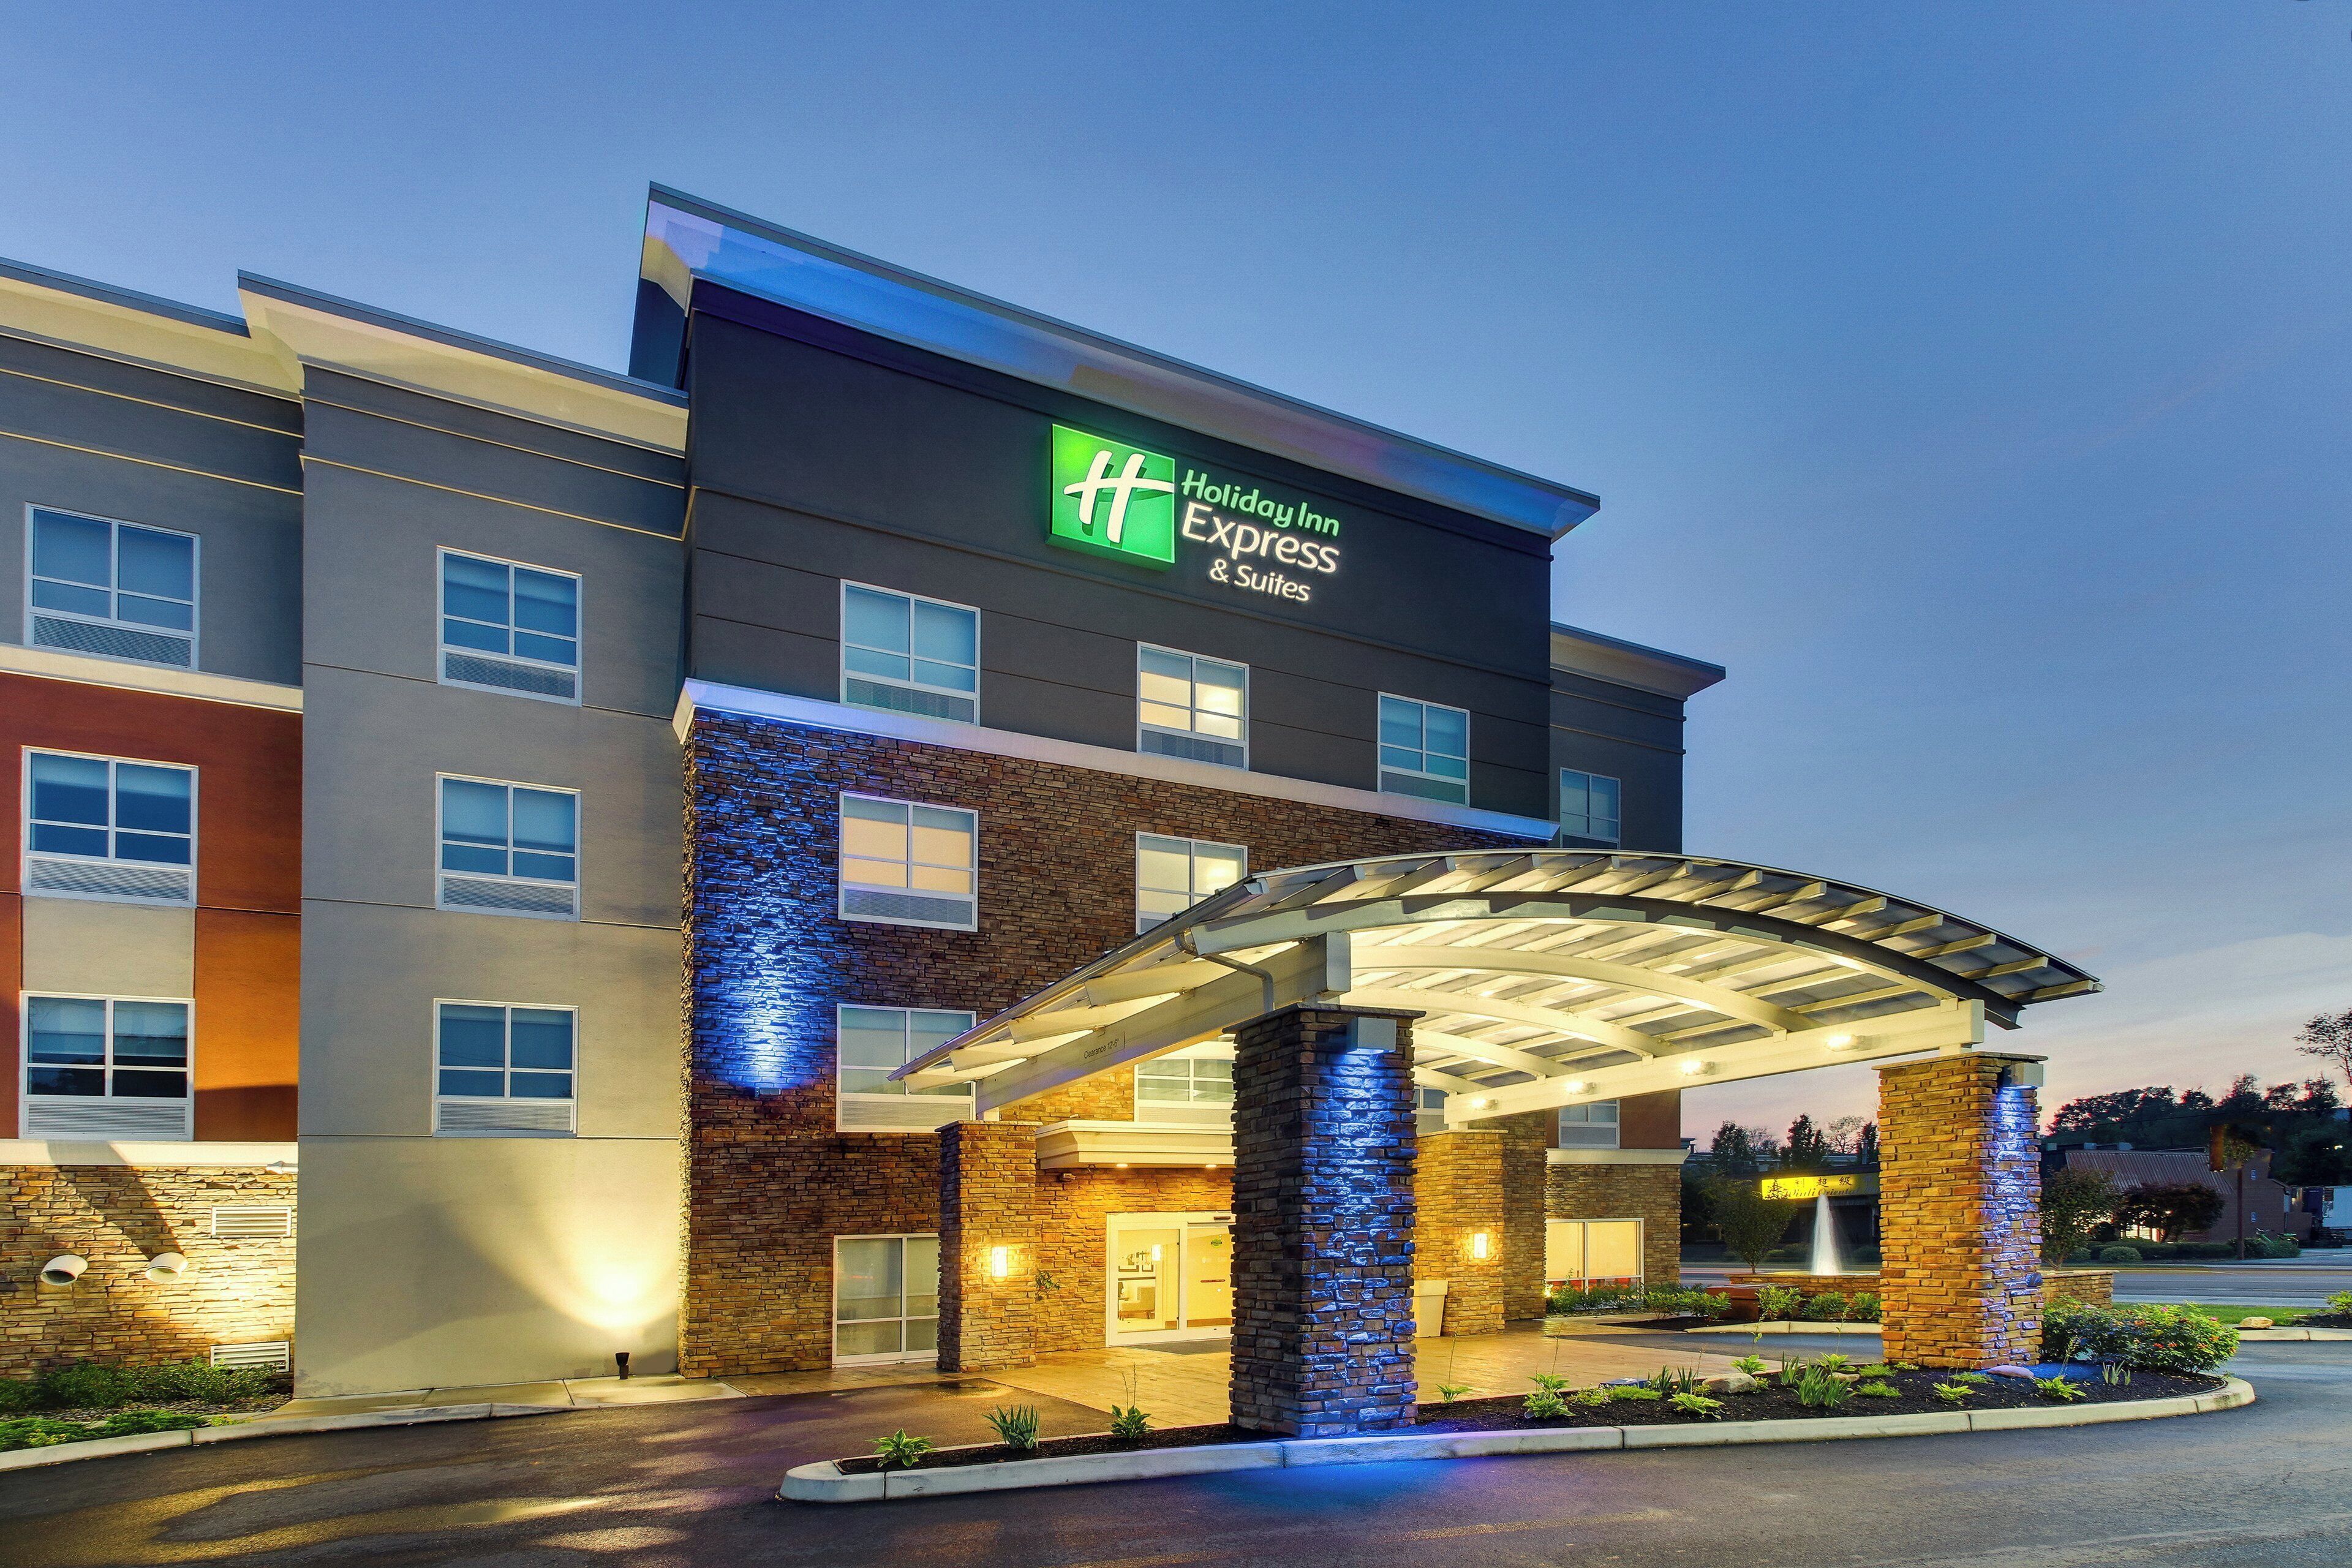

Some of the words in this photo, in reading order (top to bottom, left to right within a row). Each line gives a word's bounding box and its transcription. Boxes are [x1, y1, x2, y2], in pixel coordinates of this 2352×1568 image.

[1181, 469, 1293, 527] Holiday
[1297, 502, 1340, 537] Inn
[1182, 502, 1340, 574] Express
[1209, 558, 1229, 584] &
[1234, 565, 1311, 602] Suites
[1084, 1045, 1106, 1058] Clearance
